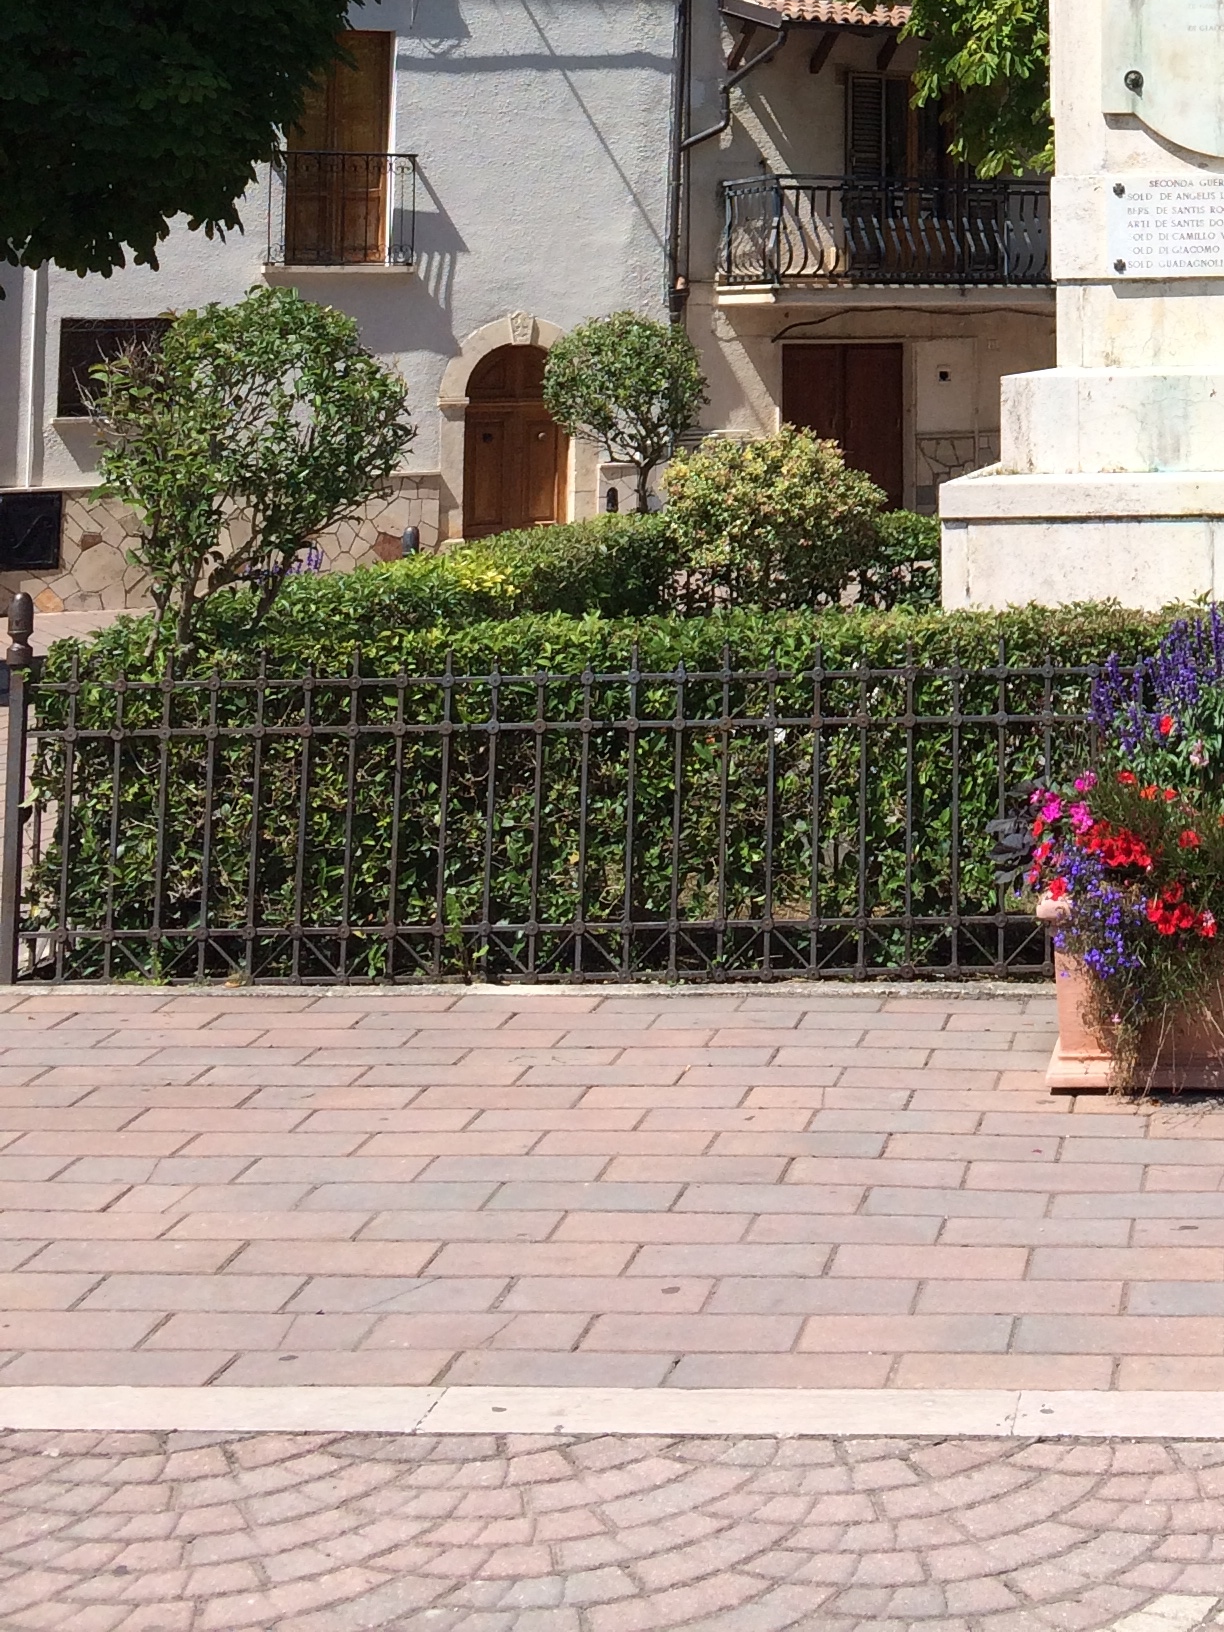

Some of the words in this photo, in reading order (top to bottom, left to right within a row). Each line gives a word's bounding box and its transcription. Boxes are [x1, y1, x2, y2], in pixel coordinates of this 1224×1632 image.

[1149, 179, 1194, 187] SECONDA
[1160, 192, 1172, 200] DE
[1176, 192, 1215, 200] ANGELIS
[1156, 206, 1168, 214] DE
[1172, 206, 1205, 214] SANTIS
[1155, 220, 1167, 228] DE
[1171, 219, 1204, 227] SANTIS
[1172, 232, 1215, 240] CAMILLO
[1159, 246, 1168, 254] DI
[1172, 245, 1220, 254] GIACOMO
[1159, 259, 1223, 268] GUADAGNOLI
